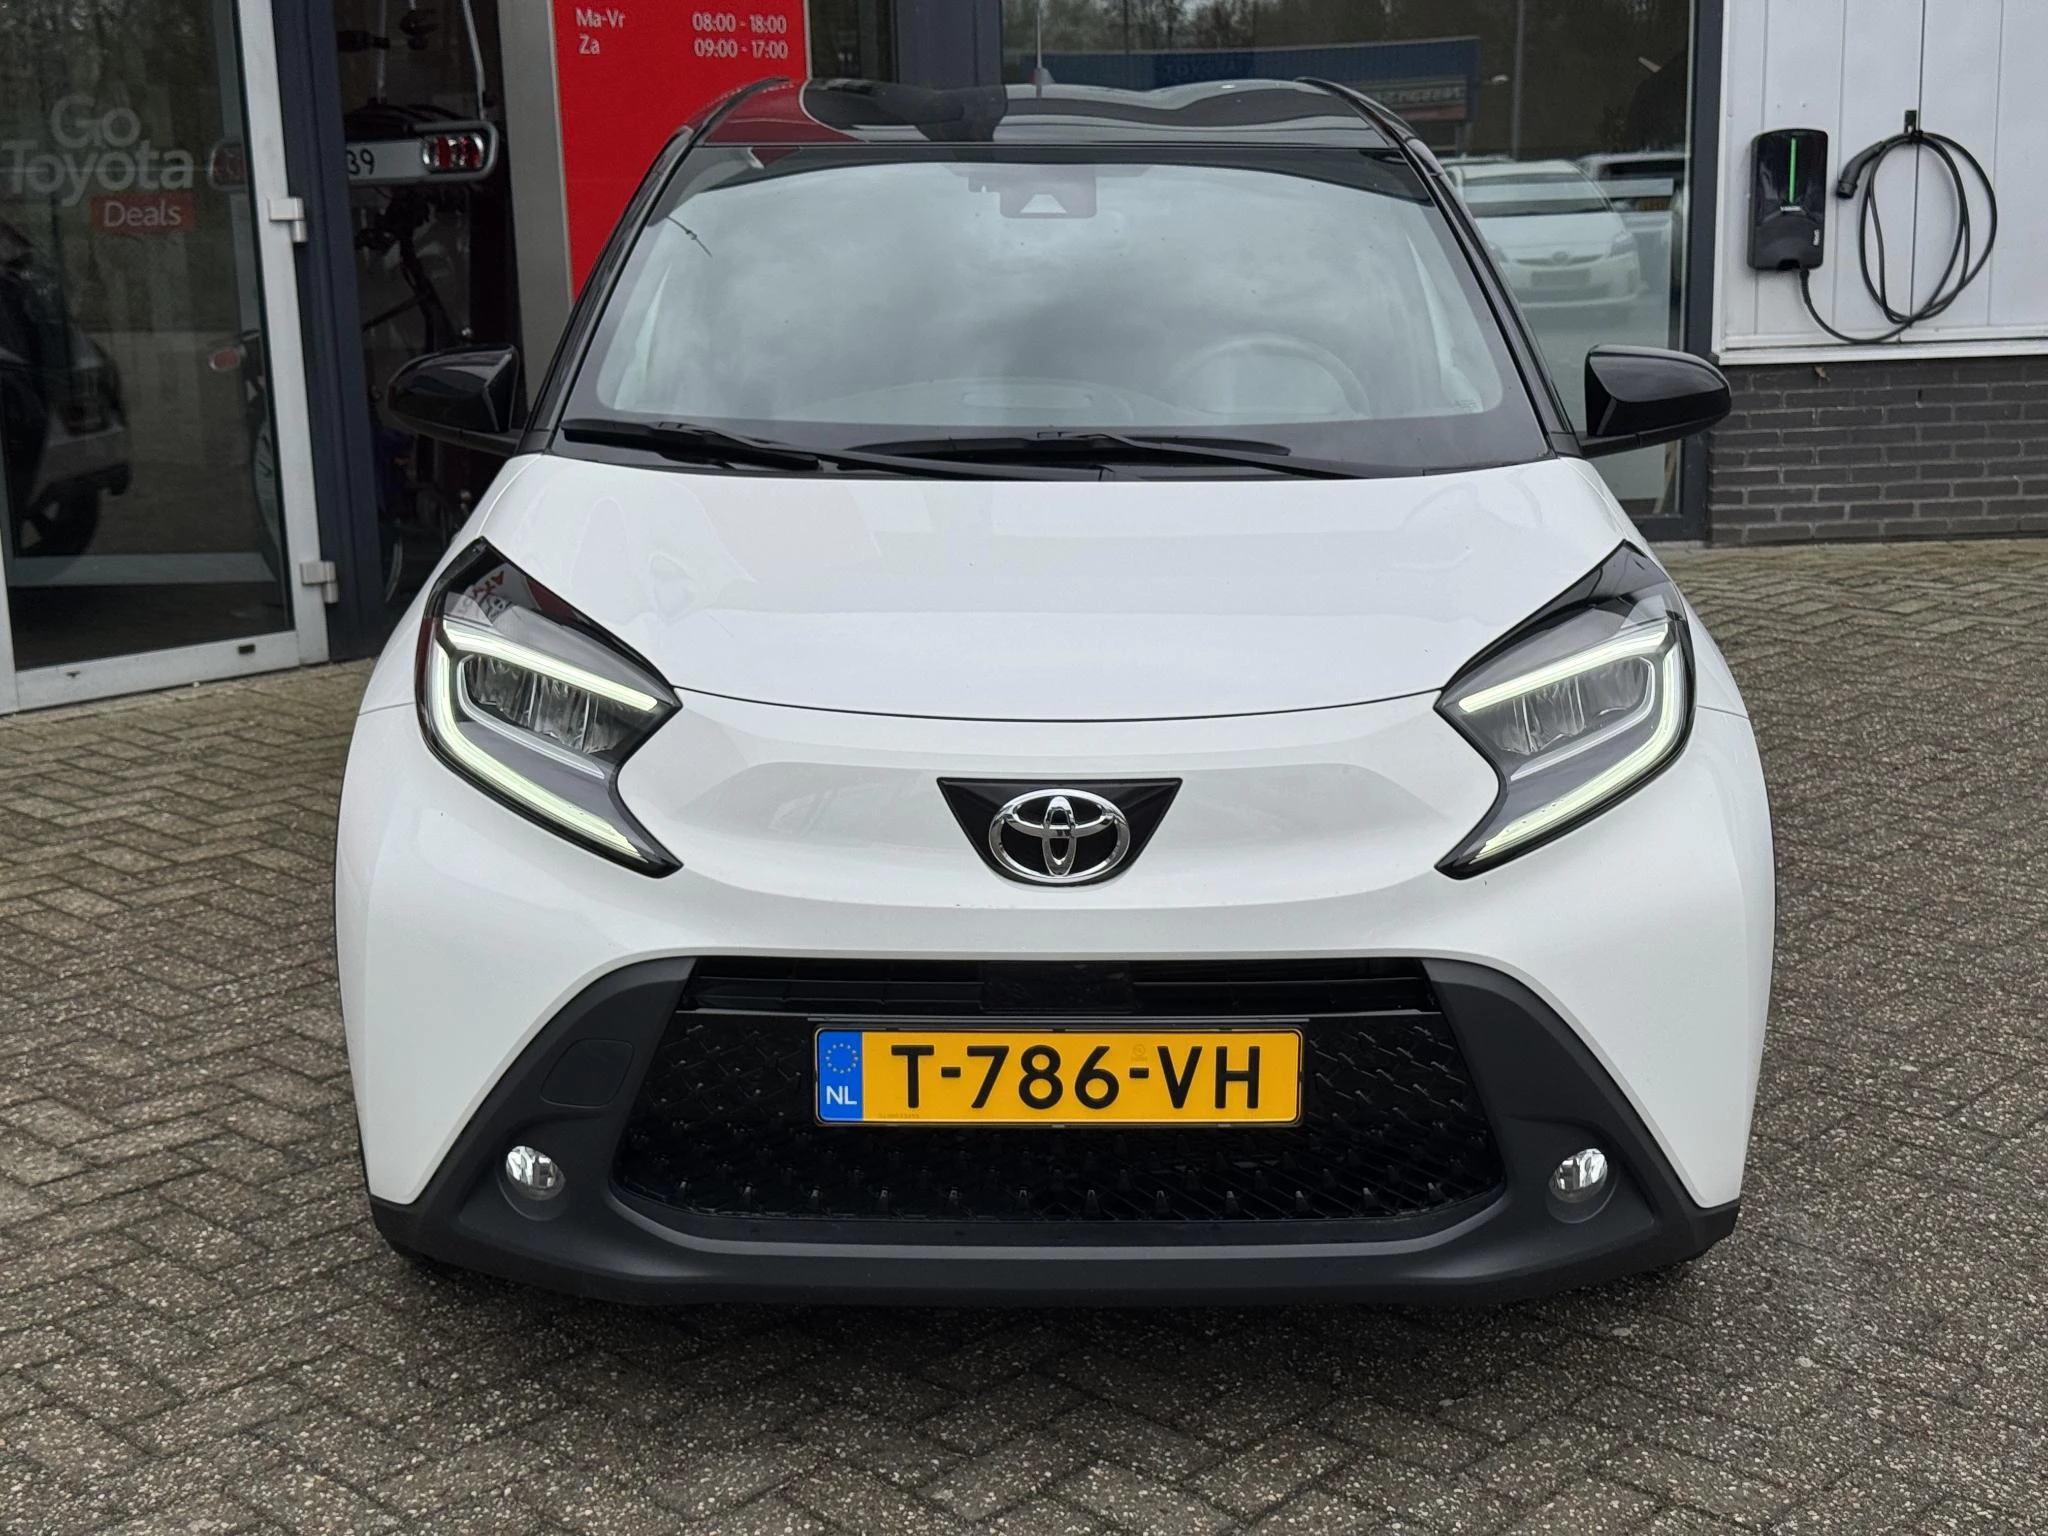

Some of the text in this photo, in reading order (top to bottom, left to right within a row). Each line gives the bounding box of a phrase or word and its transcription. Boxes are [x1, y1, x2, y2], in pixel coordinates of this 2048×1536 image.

[576, 8, 625, 28] Ma-Vr
[692, 12, 736, 32] 08:00
[750, 14, 787, 34] 18:00
[579, 33, 600, 55] Za
[694, 39, 738, 58] 09:00
[751, 40, 788, 59] 17:00
[50, 94, 141, 148] Go
[1, 139, 194, 207] Toyota
[103, 200, 183, 228] Deals
[890, 1044, 1261, 1111] T-786-VH
[825, 1085, 858, 1105] NL
